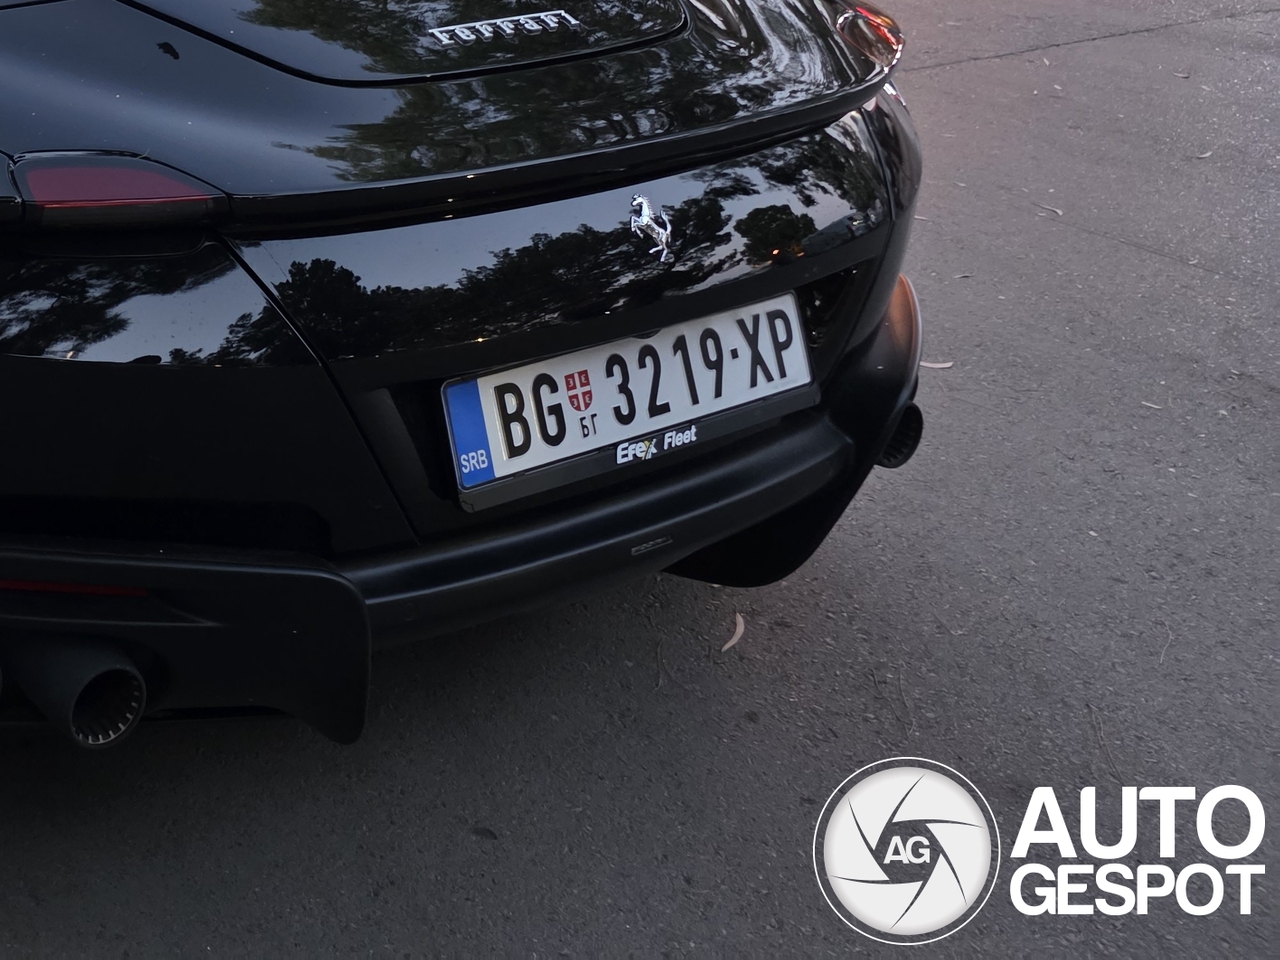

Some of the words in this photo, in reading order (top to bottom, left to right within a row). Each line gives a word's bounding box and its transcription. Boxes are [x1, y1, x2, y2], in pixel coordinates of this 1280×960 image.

[428, 9, 580, 46] Ferrari
[492, 372, 567, 460] BG
[663, 424, 698, 451] Fleet
[460, 449, 489, 474] SRB
